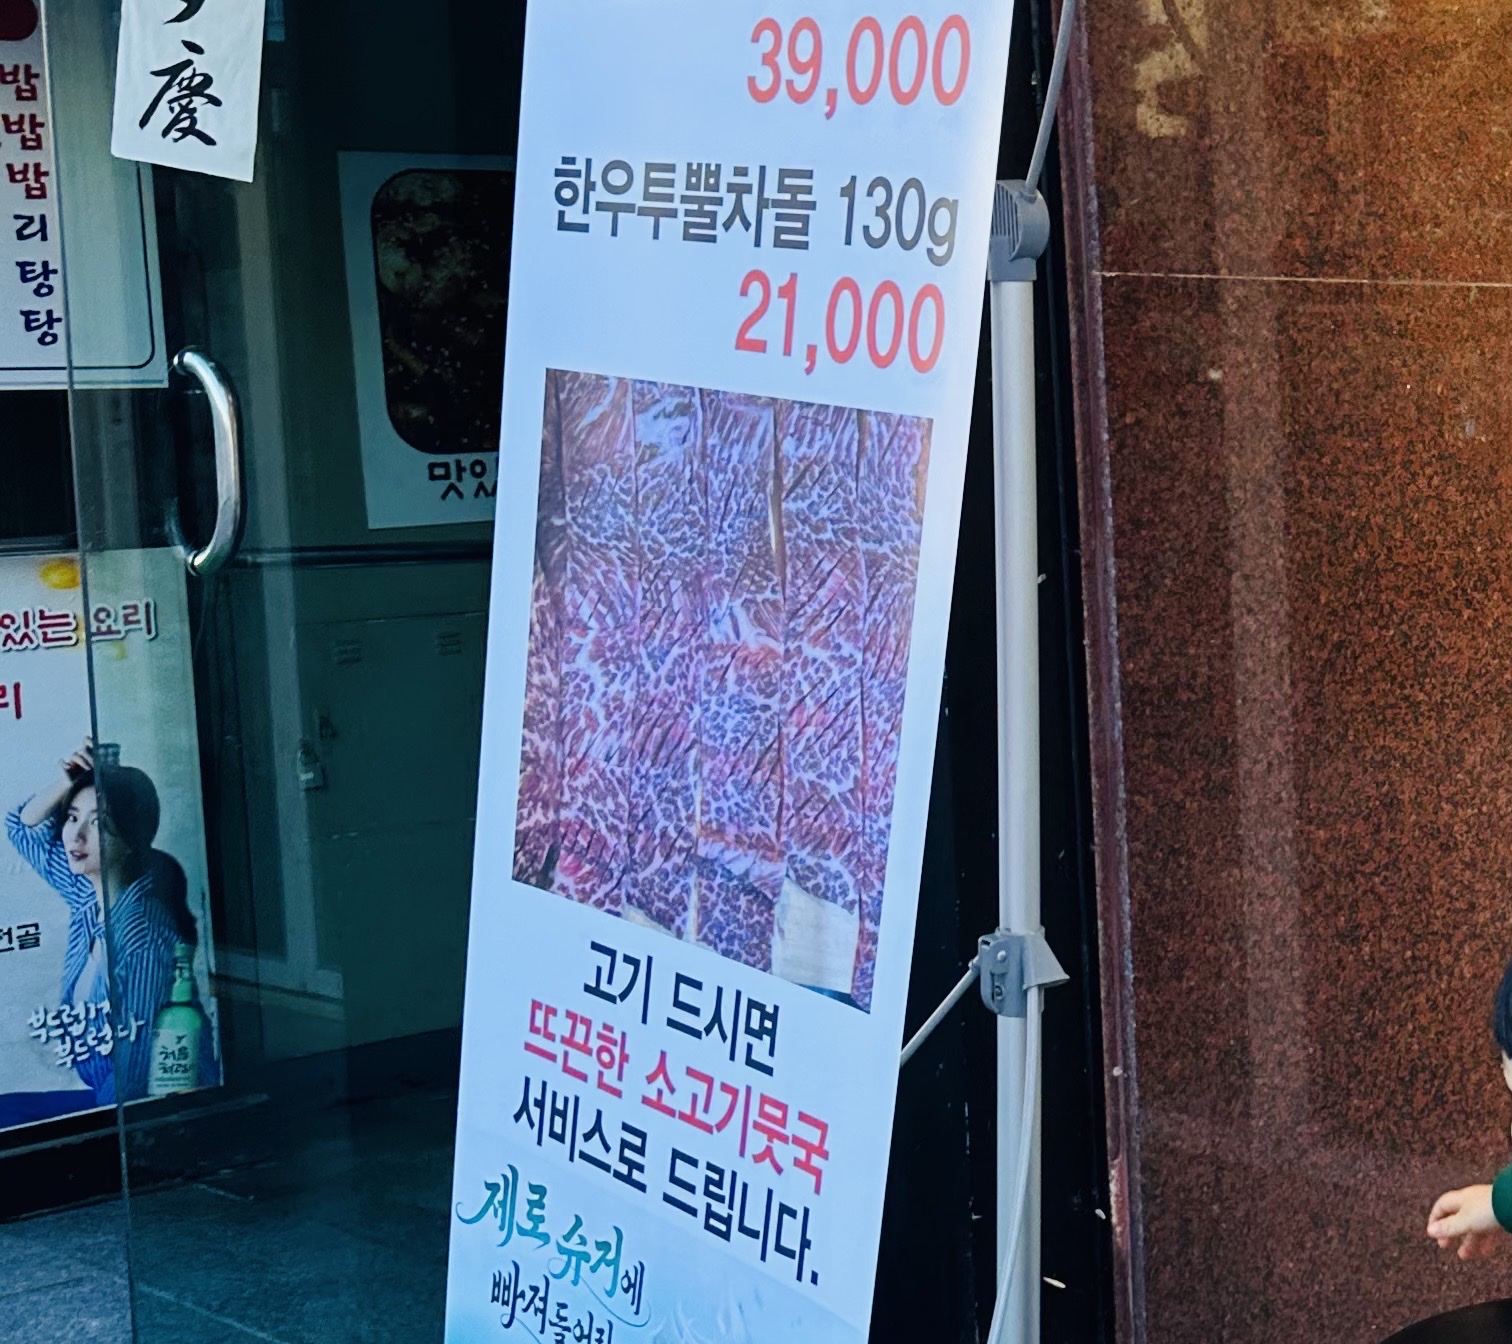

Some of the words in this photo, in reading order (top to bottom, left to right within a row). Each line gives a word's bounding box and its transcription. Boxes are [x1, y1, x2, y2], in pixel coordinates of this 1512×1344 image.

[747, 14, 970, 120] 39,000
[6, 162, 49, 199] 밥
[13, 213, 48, 242] 리
[553, 156, 817, 250] 한우투뿔차돌
[839, 174, 959, 266] 130g
[15, 260, 58, 298] 탕
[735, 269, 945, 376] 21,000
[20, 309, 62, 346] 탕
[91, 599, 156, 641] 요리
[584, 940, 653, 1025] 고기
[666, 971, 781, 1077] 드시면
[523, 998, 630, 1099] 뜨끈한
[641, 1049, 830, 1195] 소고기뭇국
[456, 1163, 551, 1250] 제로
[513, 1075, 648, 1194] 서비스로
[662, 1146, 819, 1287] 드립니다.
